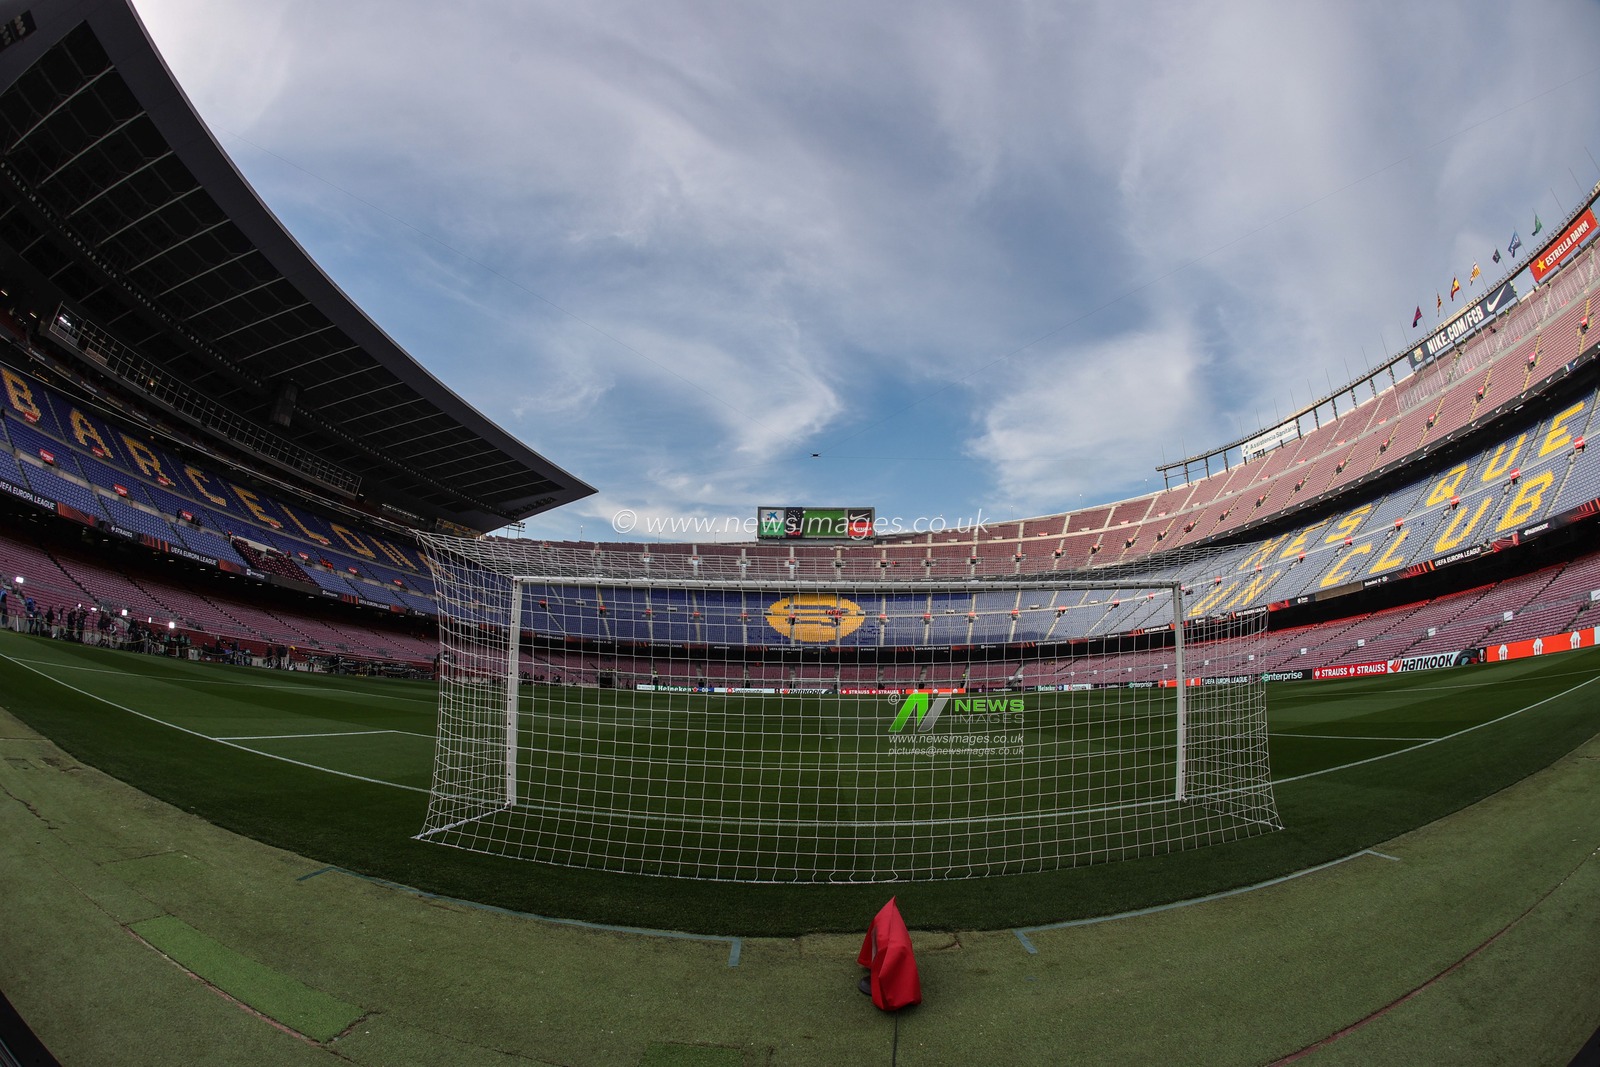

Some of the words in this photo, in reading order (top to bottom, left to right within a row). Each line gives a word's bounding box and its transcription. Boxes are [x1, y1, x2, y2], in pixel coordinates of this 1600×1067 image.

[1545, 240, 1573, 266] ESTRELLA
[1570, 220, 1590, 243] DAMM
[1427, 305, 1484, 355] NIKE.COM/FCB
[1426, 402, 1585, 507] QUE
[12, 487, 34, 502] EUROPA
[33, 495, 56, 510] LEAGUE
[1320, 470, 1554, 588] CLUB
[171, 546, 183, 556] UEFA
[182, 549, 200, 562] EUROPA
[199, 554, 218, 566] LEAGUE
[1434, 557, 1447, 568] UEFA
[1447, 552, 1464, 564] EUROPA
[1263, 670, 1303, 683] enterprise
[1321, 667, 1348, 678] STRAUSS
[1356, 663, 1386, 674] STRAUSS
[658, 684, 692, 693] Heineken
